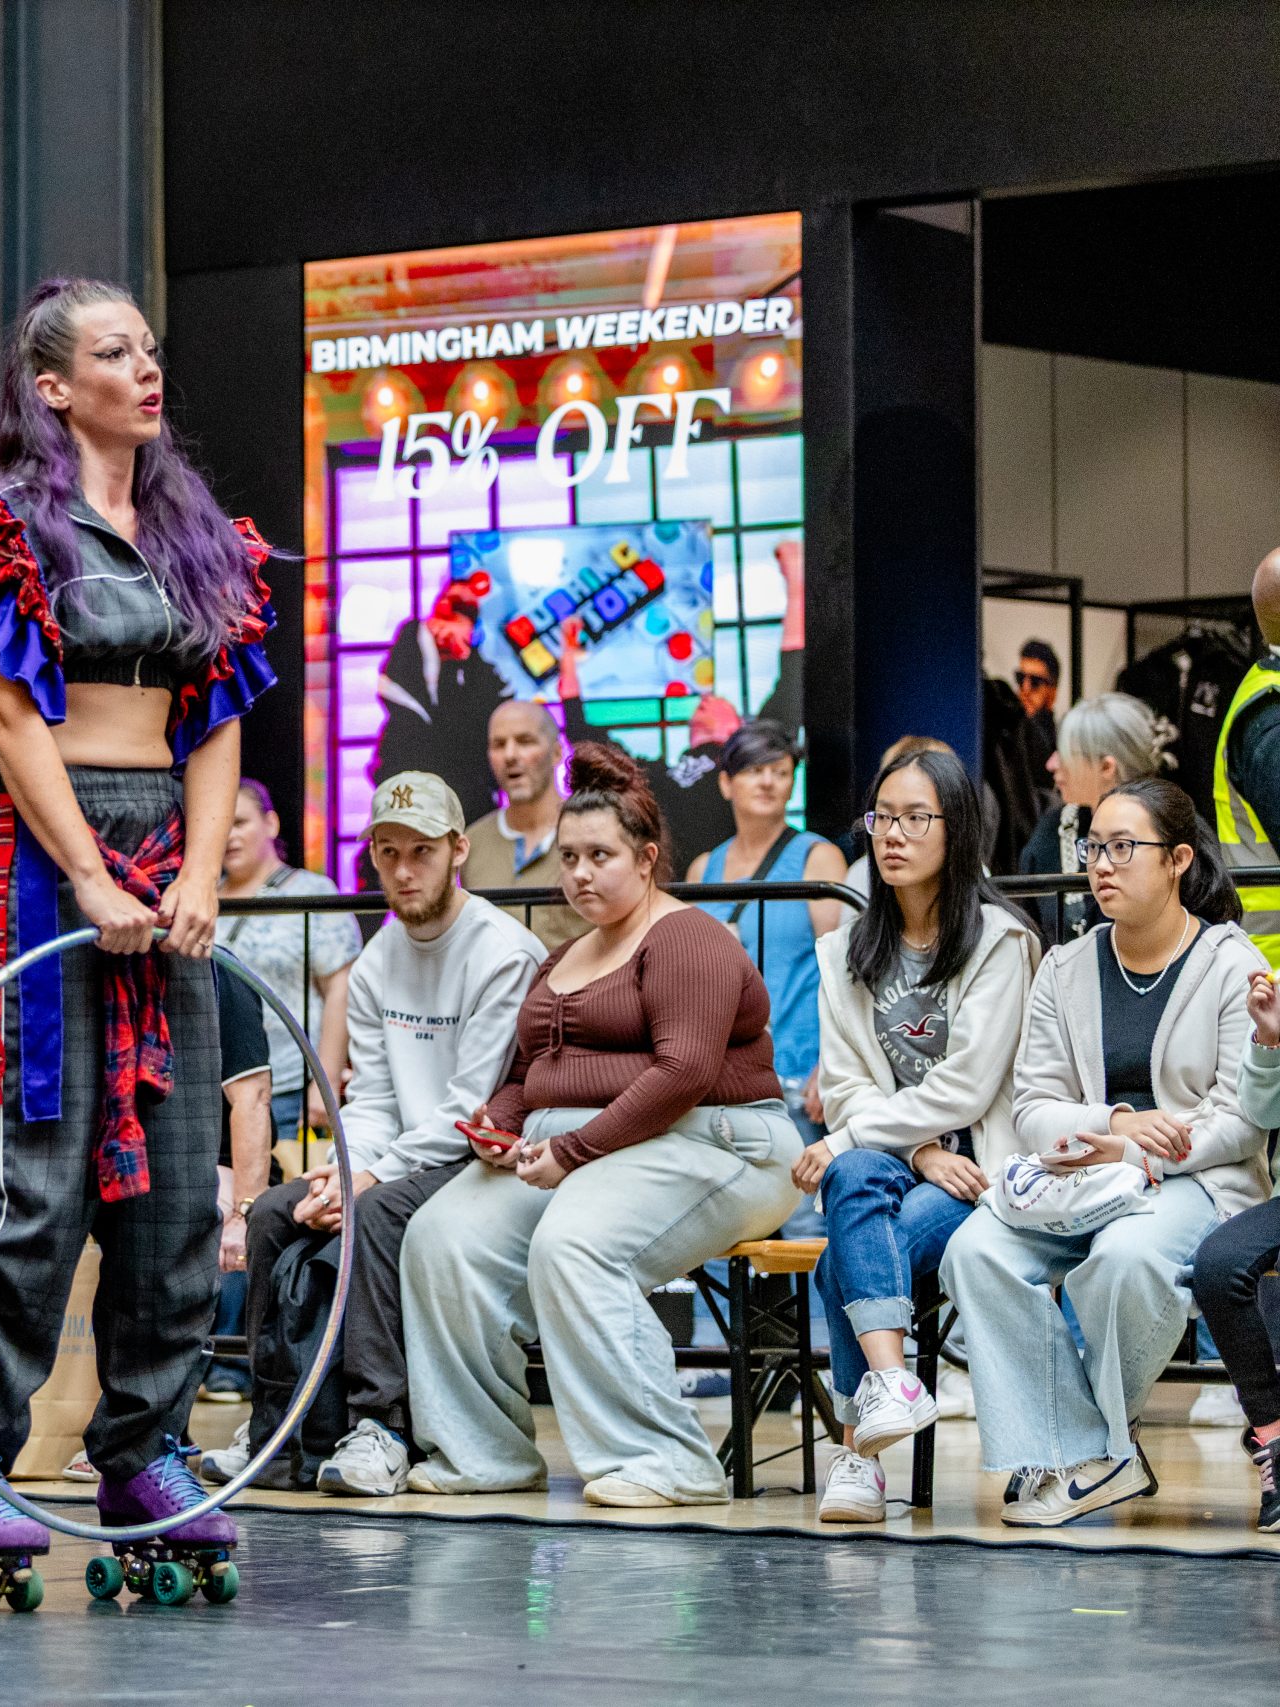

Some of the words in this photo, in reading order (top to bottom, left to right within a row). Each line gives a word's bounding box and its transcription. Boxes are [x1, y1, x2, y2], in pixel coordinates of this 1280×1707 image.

[311, 319, 544, 373] BIRMINGHAM
[556, 297, 794, 350] WEEKENDER
[368, 411, 500, 502] 15%
[535, 387, 731, 488] OFF
[383, 1009, 423, 1024] ISTRY
[877, 1032, 907, 1065] SURF
